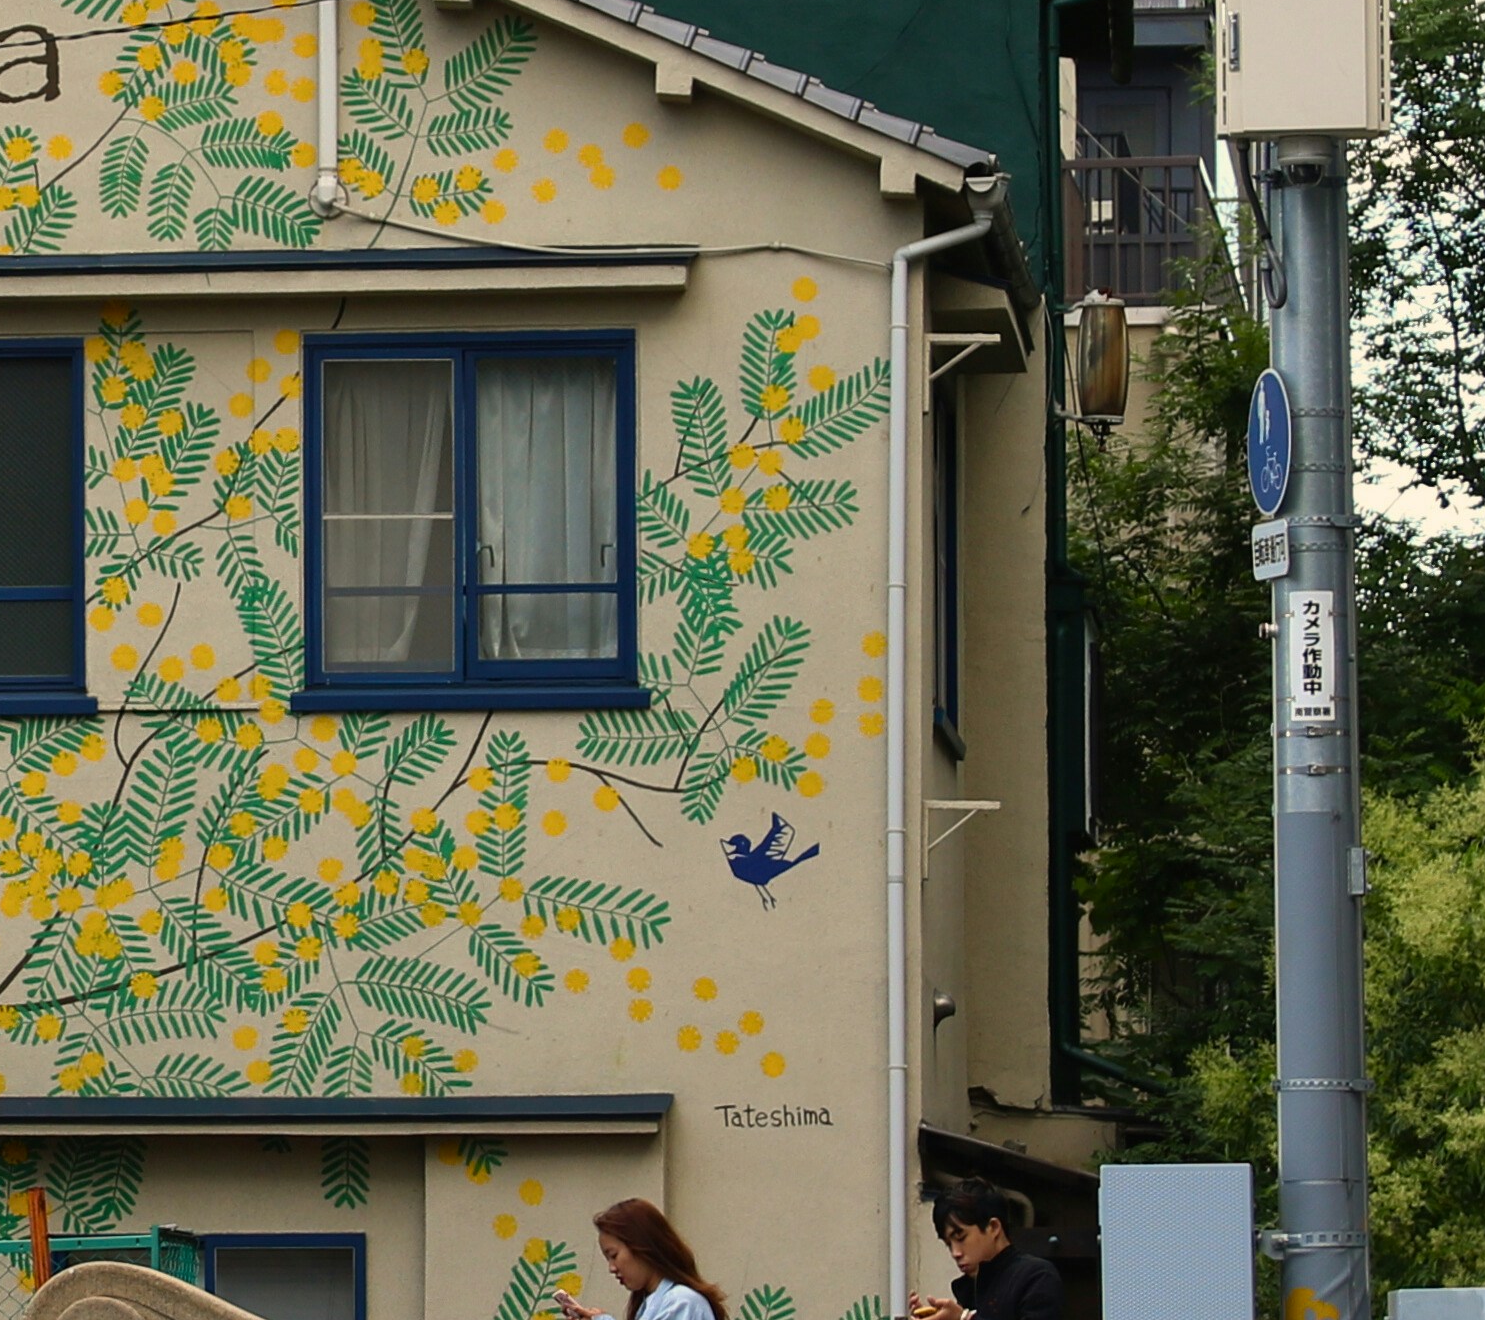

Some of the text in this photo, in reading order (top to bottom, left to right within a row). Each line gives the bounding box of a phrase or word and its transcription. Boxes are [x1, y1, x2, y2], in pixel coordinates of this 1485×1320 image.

[1302, 600, 1322, 696] カメラ作動中
[714, 1104, 834, 1128] Tateshima
